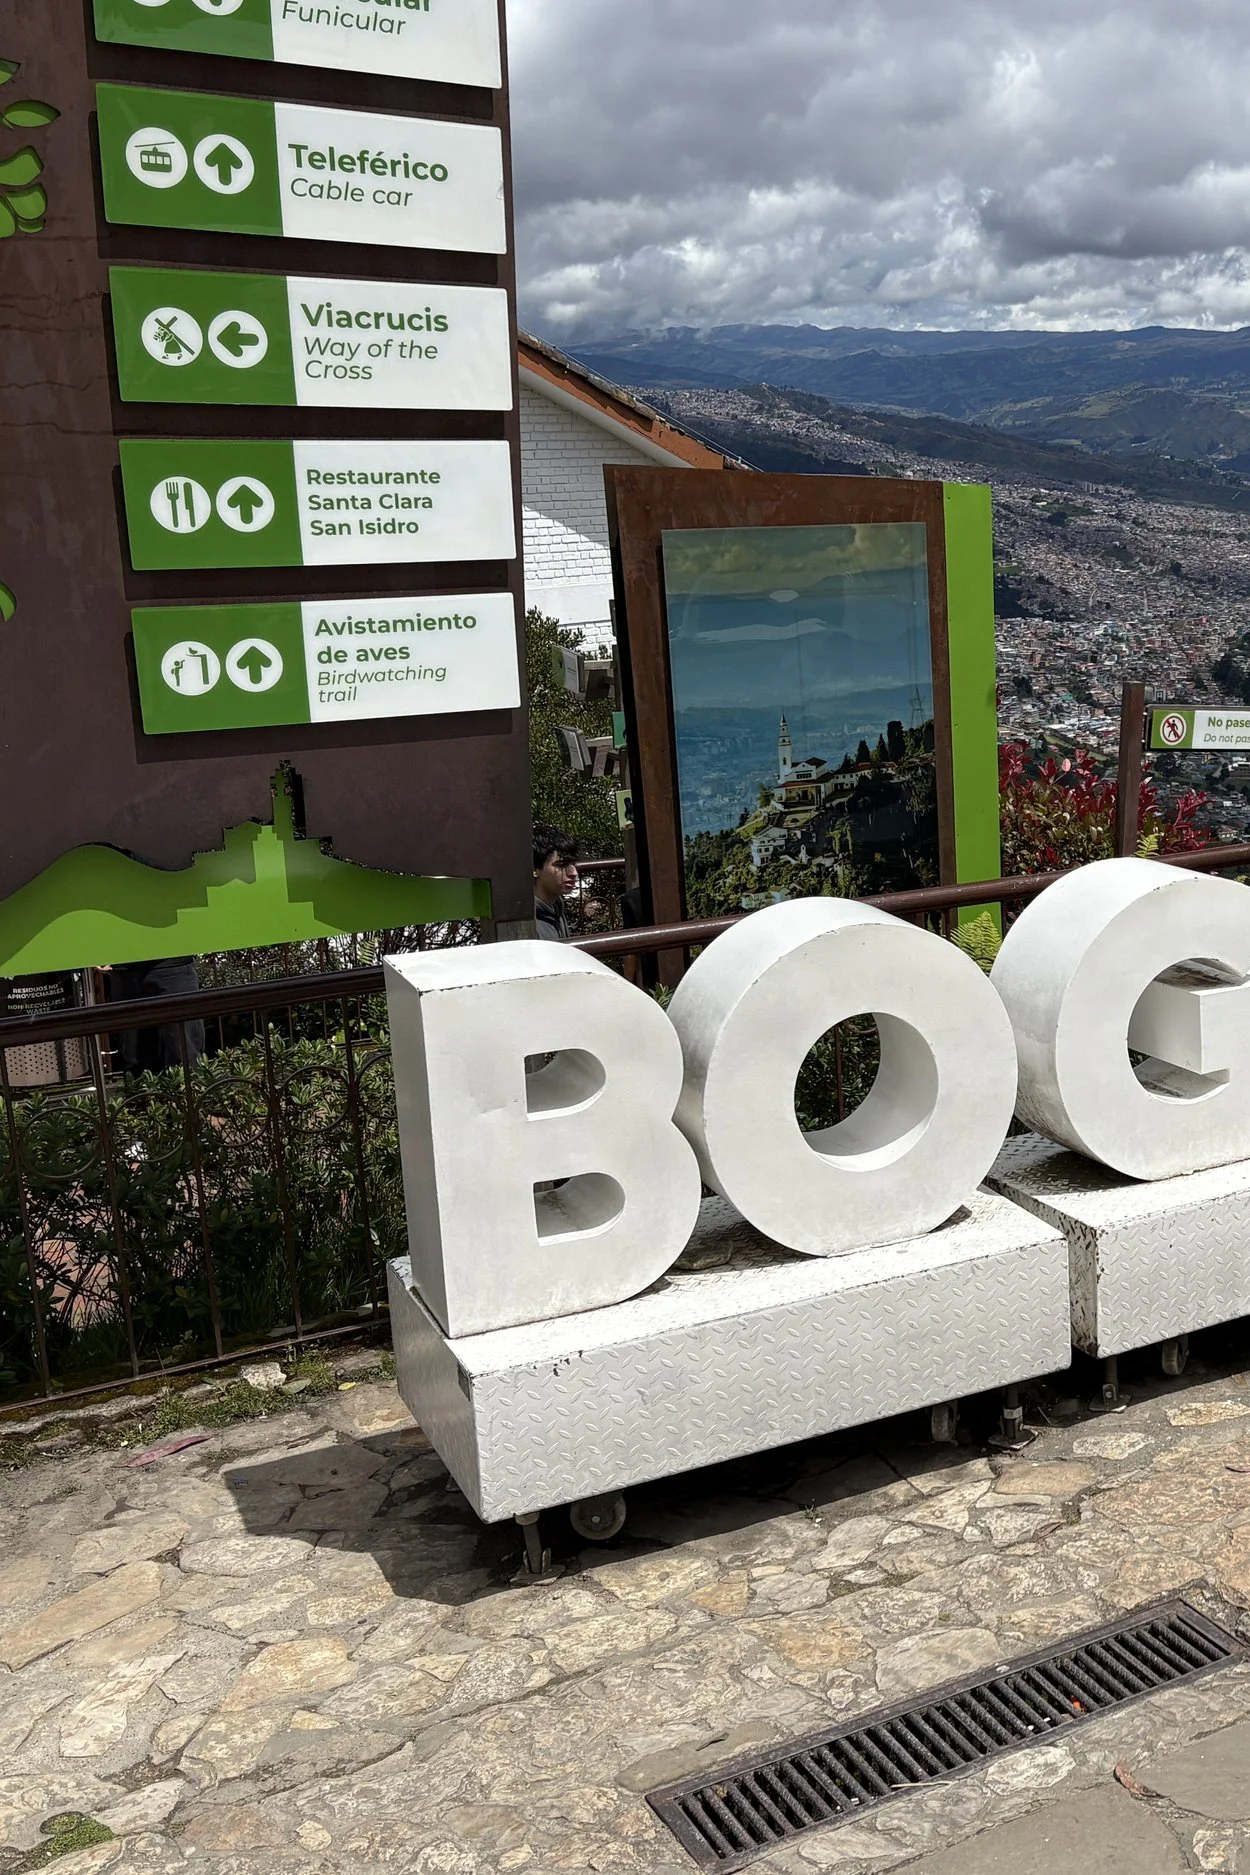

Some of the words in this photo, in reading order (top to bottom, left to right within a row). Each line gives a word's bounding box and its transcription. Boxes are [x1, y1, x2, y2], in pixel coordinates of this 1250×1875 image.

[281, 0, 406, 35] Funicular
[287, 143, 449, 182] Teleférico
[290, 177, 365, 203] Cable
[372, 189, 413, 207] car
[300, 301, 449, 333] Viacrucis
[303, 336, 361, 362] Way
[367, 339, 394, 358] of
[398, 340, 438, 359] the
[305, 359, 373, 380] Cross
[306, 468, 441, 485] Restaurante
[308, 494, 372, 511] Santa
[378, 493, 433, 510] Clara
[310, 519, 352, 536] San
[358, 517, 419, 535] Isidro
[314, 612, 477, 637] Avistamiento
[316, 646, 348, 664] de
[356, 645, 411, 662] aves
[317, 664, 447, 686] Birdwatching
[318, 686, 358, 703] trail
[1207, 716, 1223, 727] No
[1203, 733, 1216, 743] Do
[1219, 734, 1234, 743] not
[7, 988, 65, 1000] APROVECHABLES
[12, 985, 48, 993] RESIDUOS
